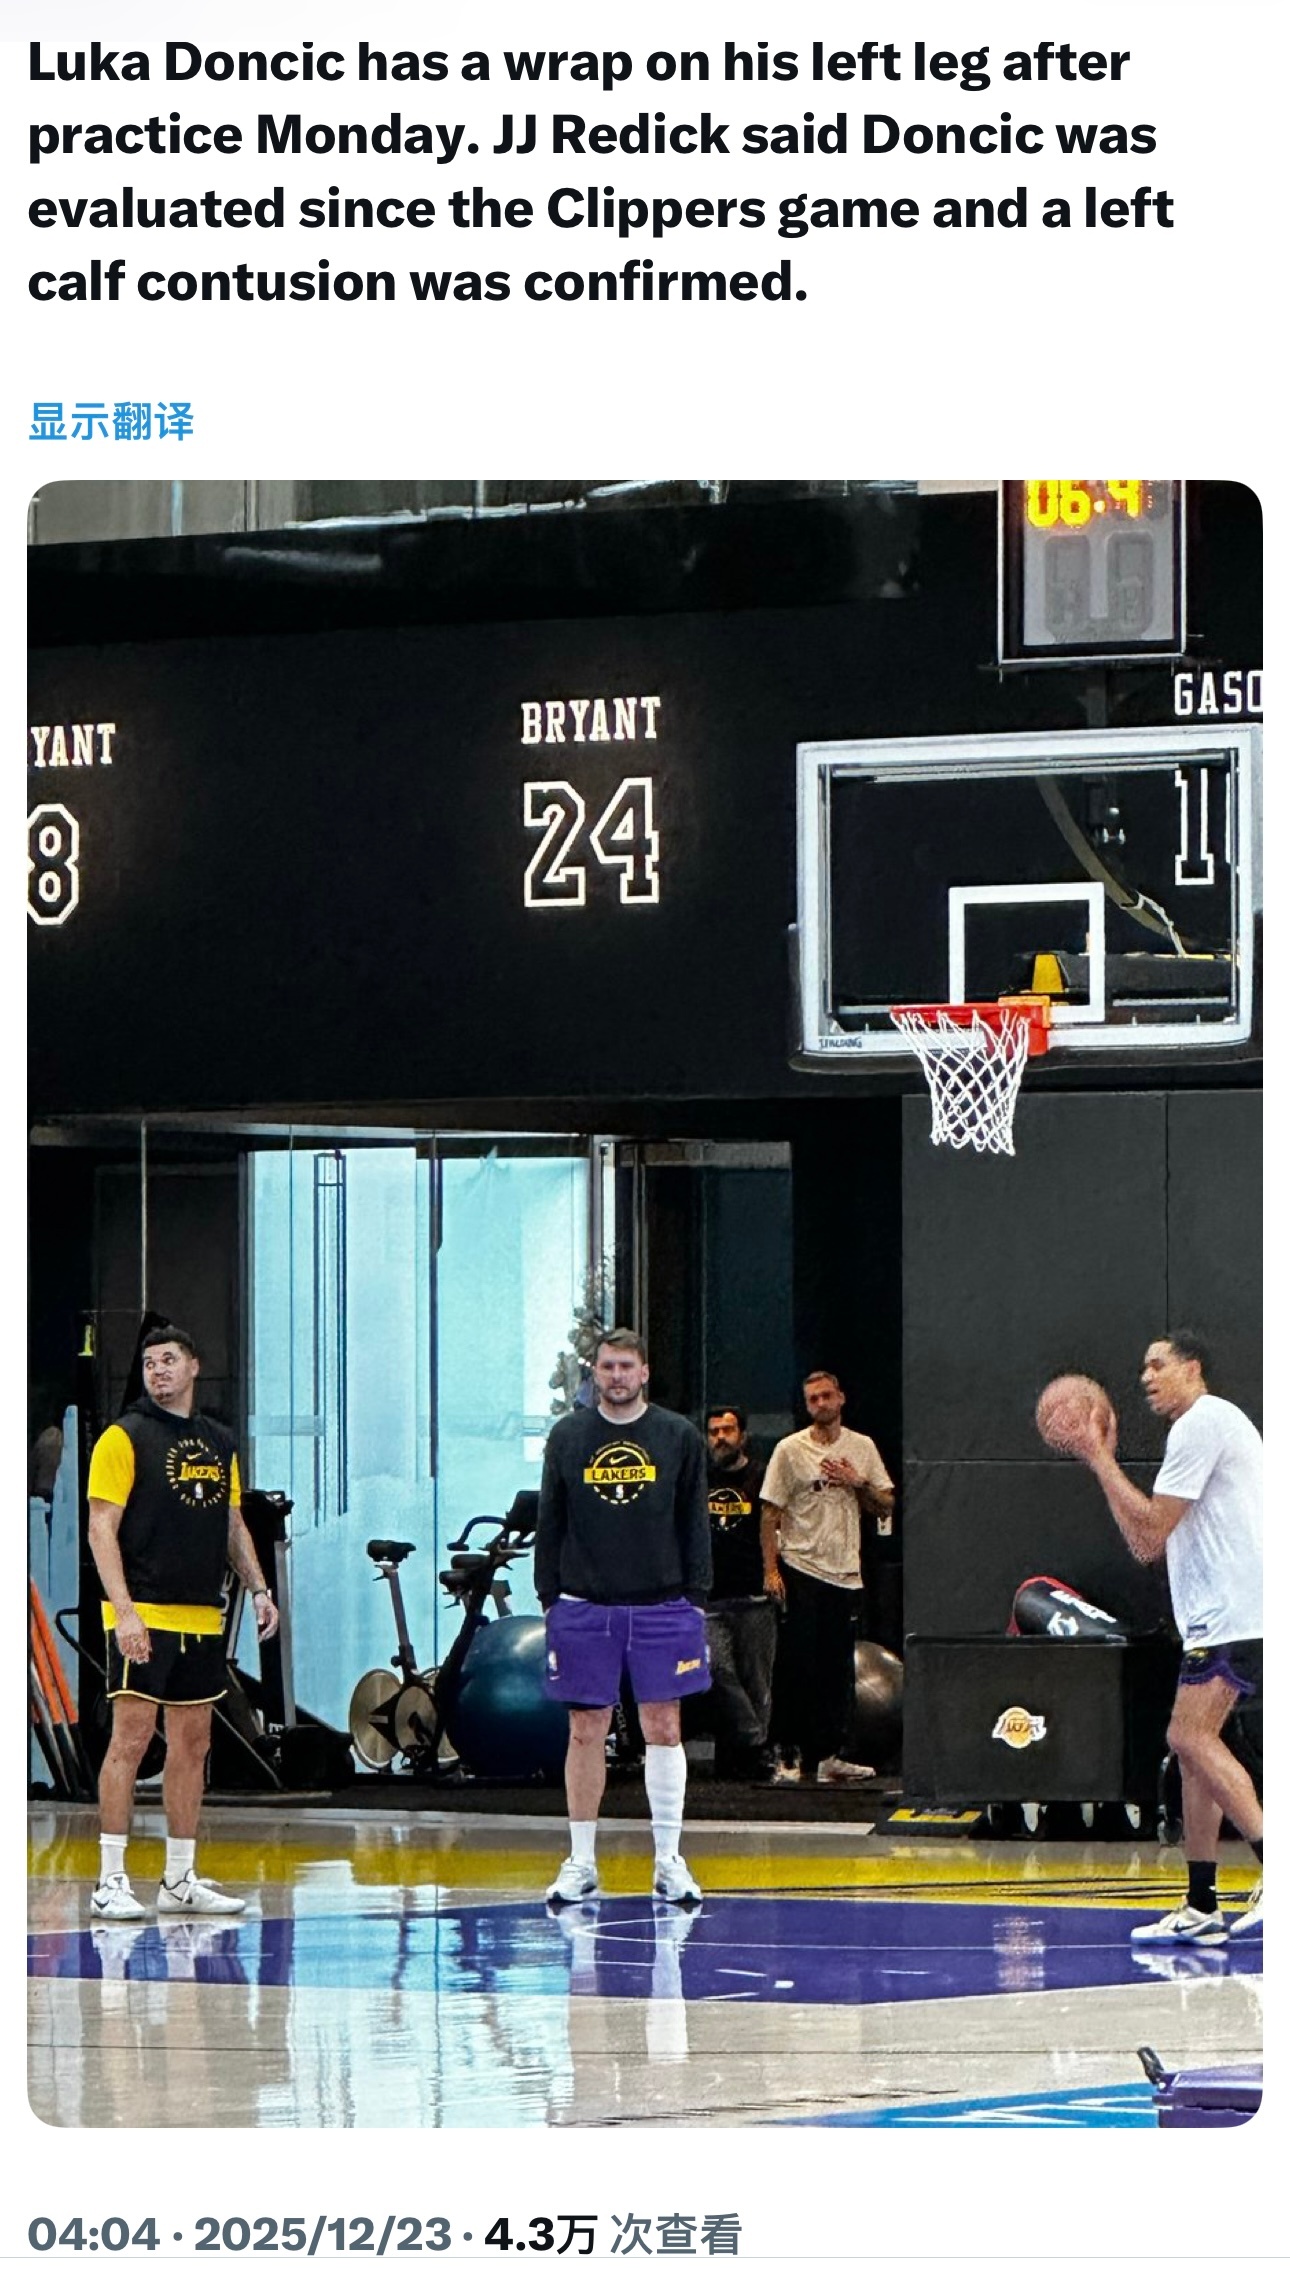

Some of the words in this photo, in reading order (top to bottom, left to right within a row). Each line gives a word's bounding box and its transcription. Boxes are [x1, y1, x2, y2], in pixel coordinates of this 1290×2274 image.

[521, 697, 661, 744] BRYANT
[1174, 671, 1264, 716] GASO
[27, 804, 79, 925] 8
[524, 777, 660, 907] 24
[1174, 767, 1232, 885] 1
[592, 1468, 646, 1481] LAKERS
